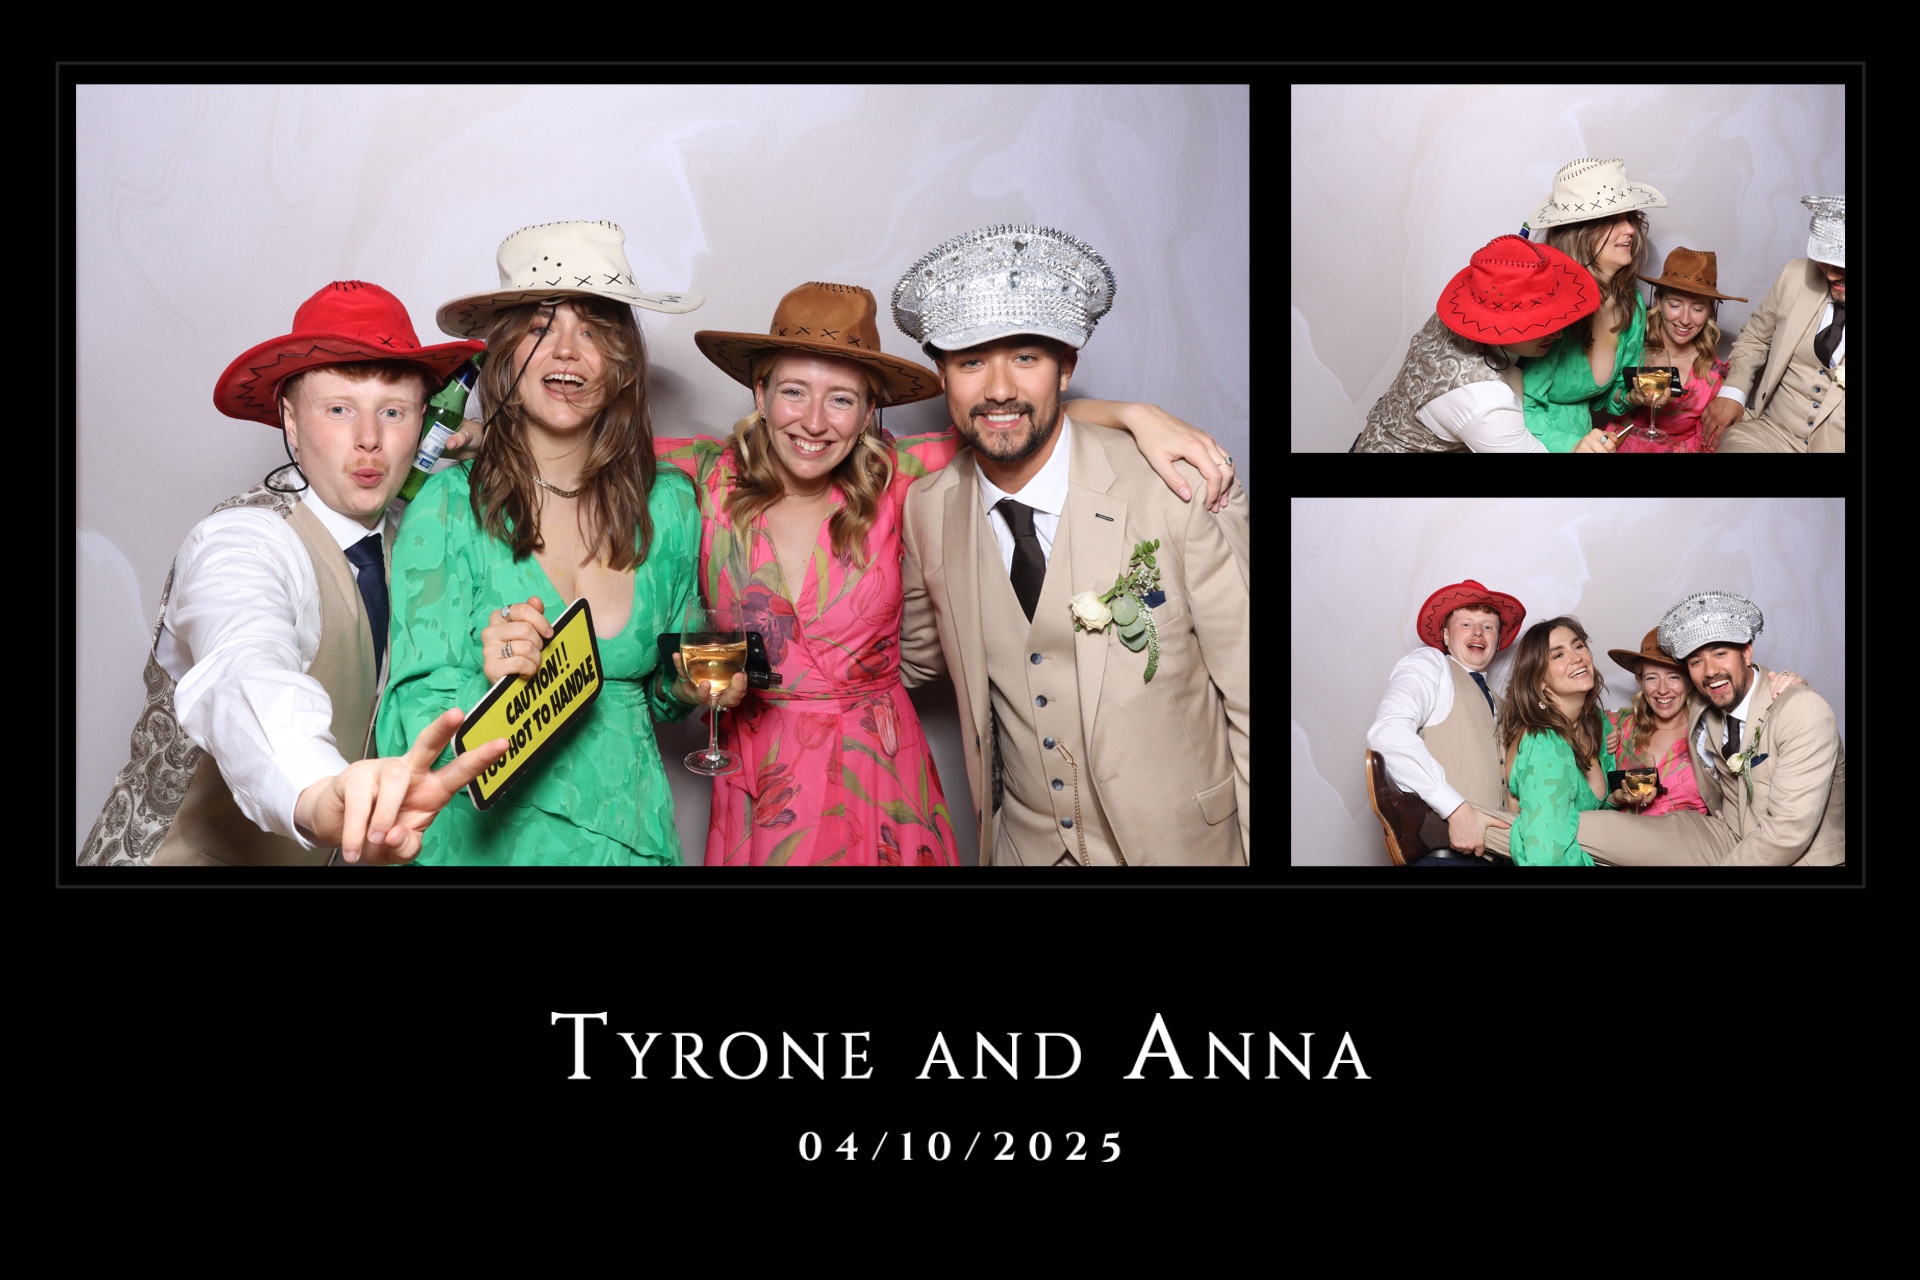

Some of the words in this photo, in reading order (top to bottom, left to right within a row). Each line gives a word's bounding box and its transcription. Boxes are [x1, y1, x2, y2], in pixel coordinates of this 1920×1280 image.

[506, 641, 570, 725] CAUTION!!
[508, 718, 533, 760] HOT
[532, 703, 551, 732] TO
[551, 655, 595, 717] HANDLE
